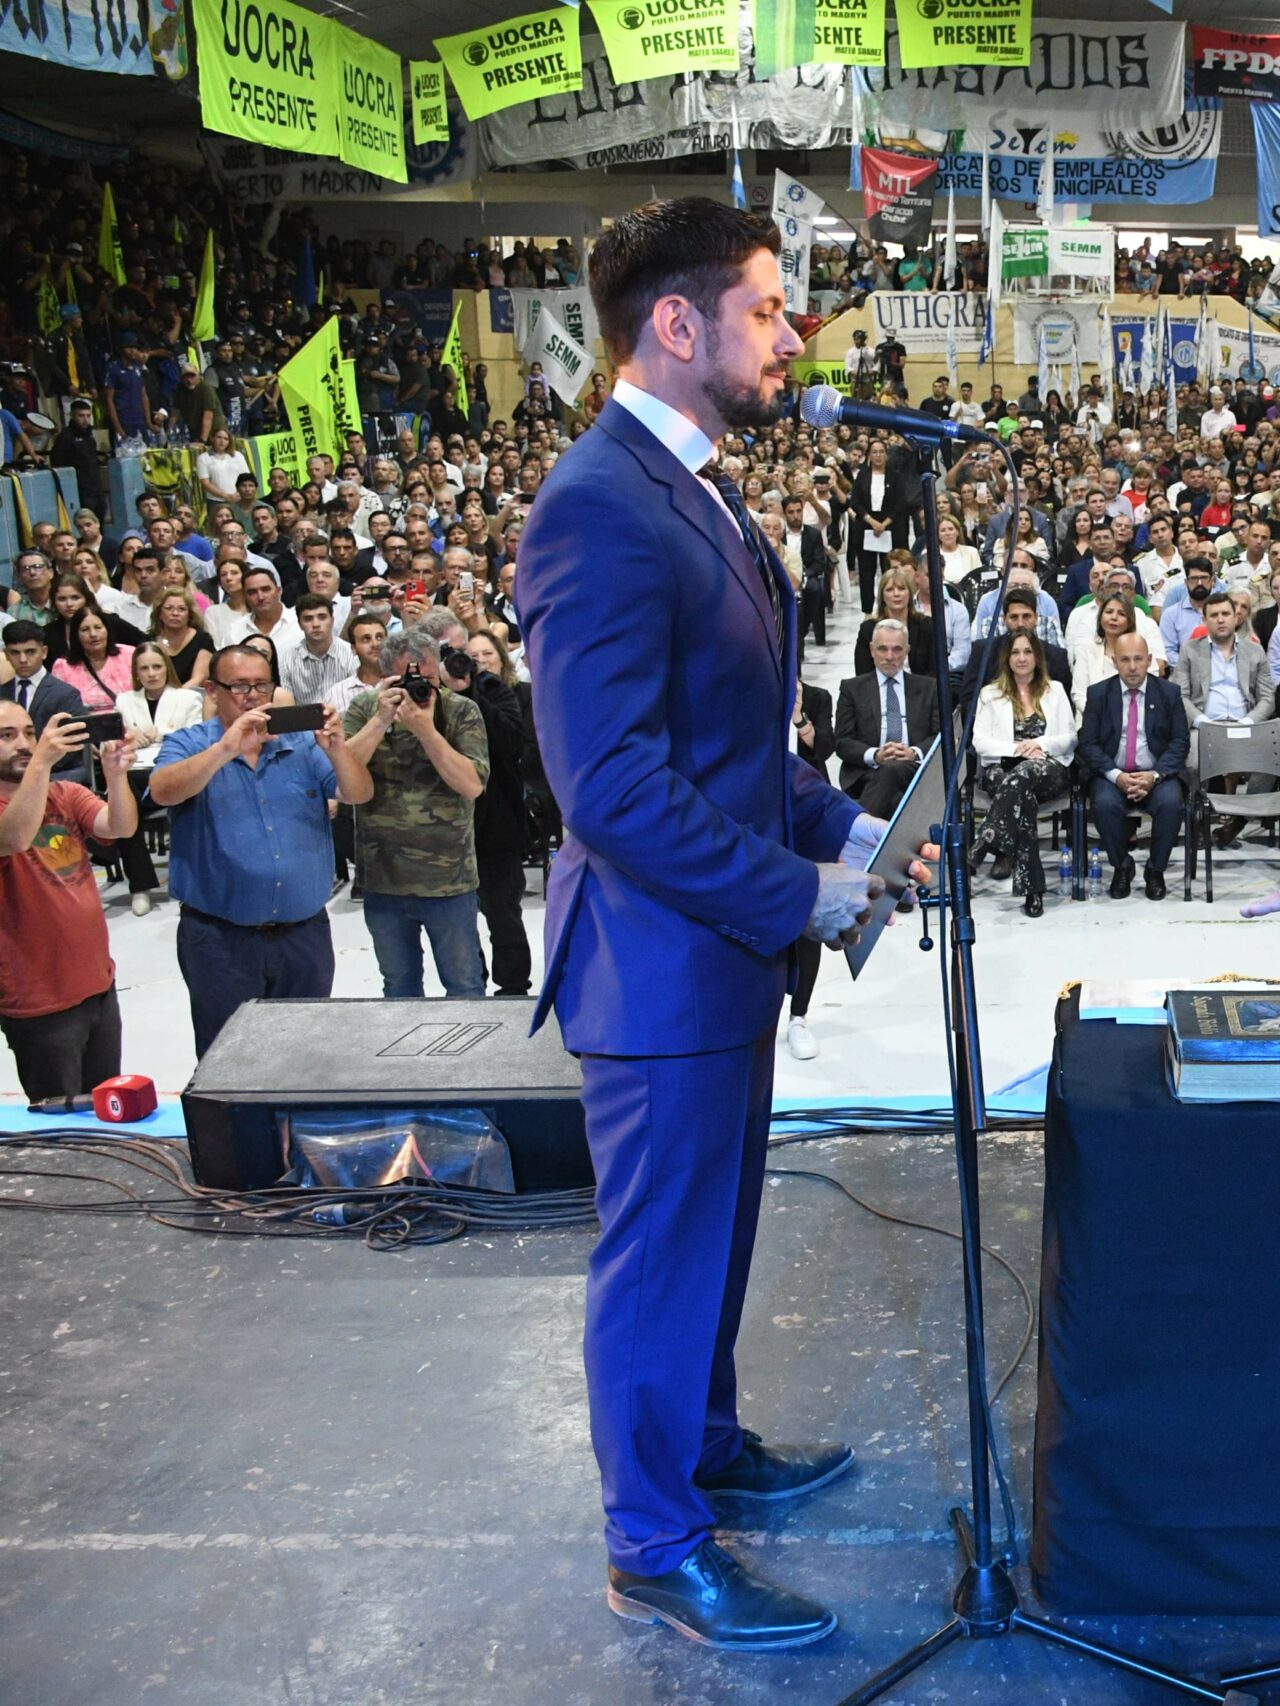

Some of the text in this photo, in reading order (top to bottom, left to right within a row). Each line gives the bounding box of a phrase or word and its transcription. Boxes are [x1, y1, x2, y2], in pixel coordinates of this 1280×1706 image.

[651, 9, 726, 26] PUERTO MADRYN
[830, 11, 868, 19] MADRYN
[947, 9, 1021, 19] PUERTO MADRYN
[221, 0, 316, 80] UOCRA
[488, 18, 564, 50] UOCRA
[494, 35, 565, 59] PUERTO MADRYN
[641, 26, 725, 56] PRESENTE
[815, 26, 863, 46] SENTE
[933, 24, 1017, 46] PRESENTE
[482, 53, 567, 92] PRESENTE
[229, 76, 318, 132] PRESENTE
[344, 61, 397, 121] UOCRA
[347, 116, 400, 158] PRESENTE
[302, 167, 383, 195] MADRYN
[878, 172, 918, 195] MTL
[1014, 160, 1041, 177] DE
[1053, 161, 1167, 180] EMPLEADOS
[1060, 241, 1102, 254] SEMM
[875, 295, 987, 329] UTHGRA
[545, 333, 582, 376] SEMM
[297, 404, 318, 456] PRESE
[276, 437, 296, 455] UOC
